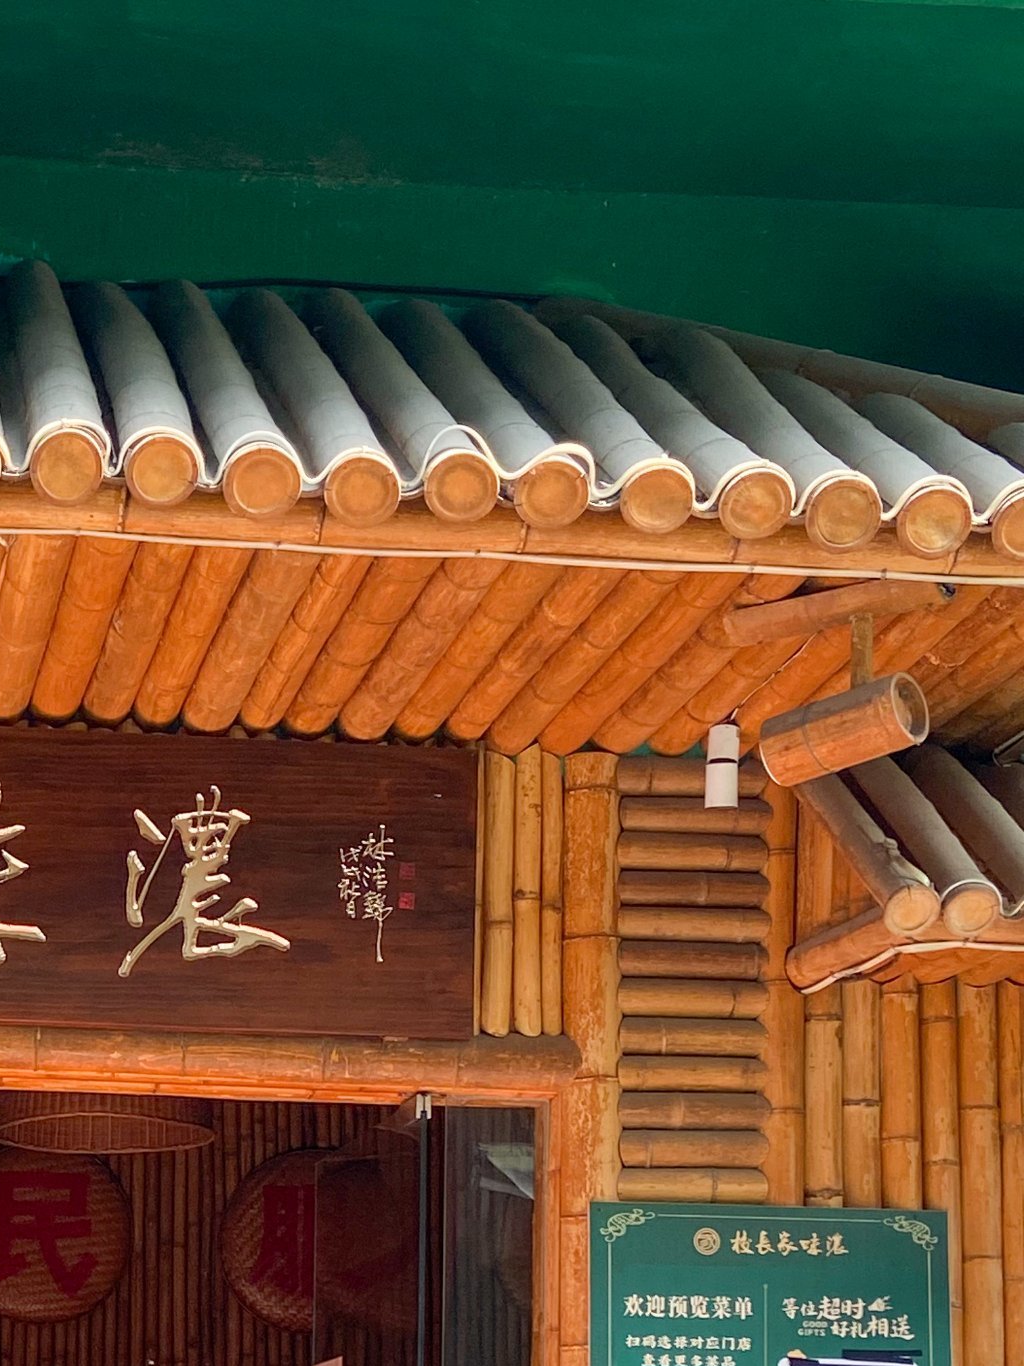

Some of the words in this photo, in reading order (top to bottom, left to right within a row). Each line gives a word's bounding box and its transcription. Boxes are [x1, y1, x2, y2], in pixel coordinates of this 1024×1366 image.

[623, 1294, 753, 1320] 欢迎预览菜单
[782, 1296, 866, 1320] 等位超时
[802, 1320, 828, 1328] GOOD
[830, 1314, 915, 1340] 好礼相送
[625, 1334, 752, 1351] 扫码选择对应门店
